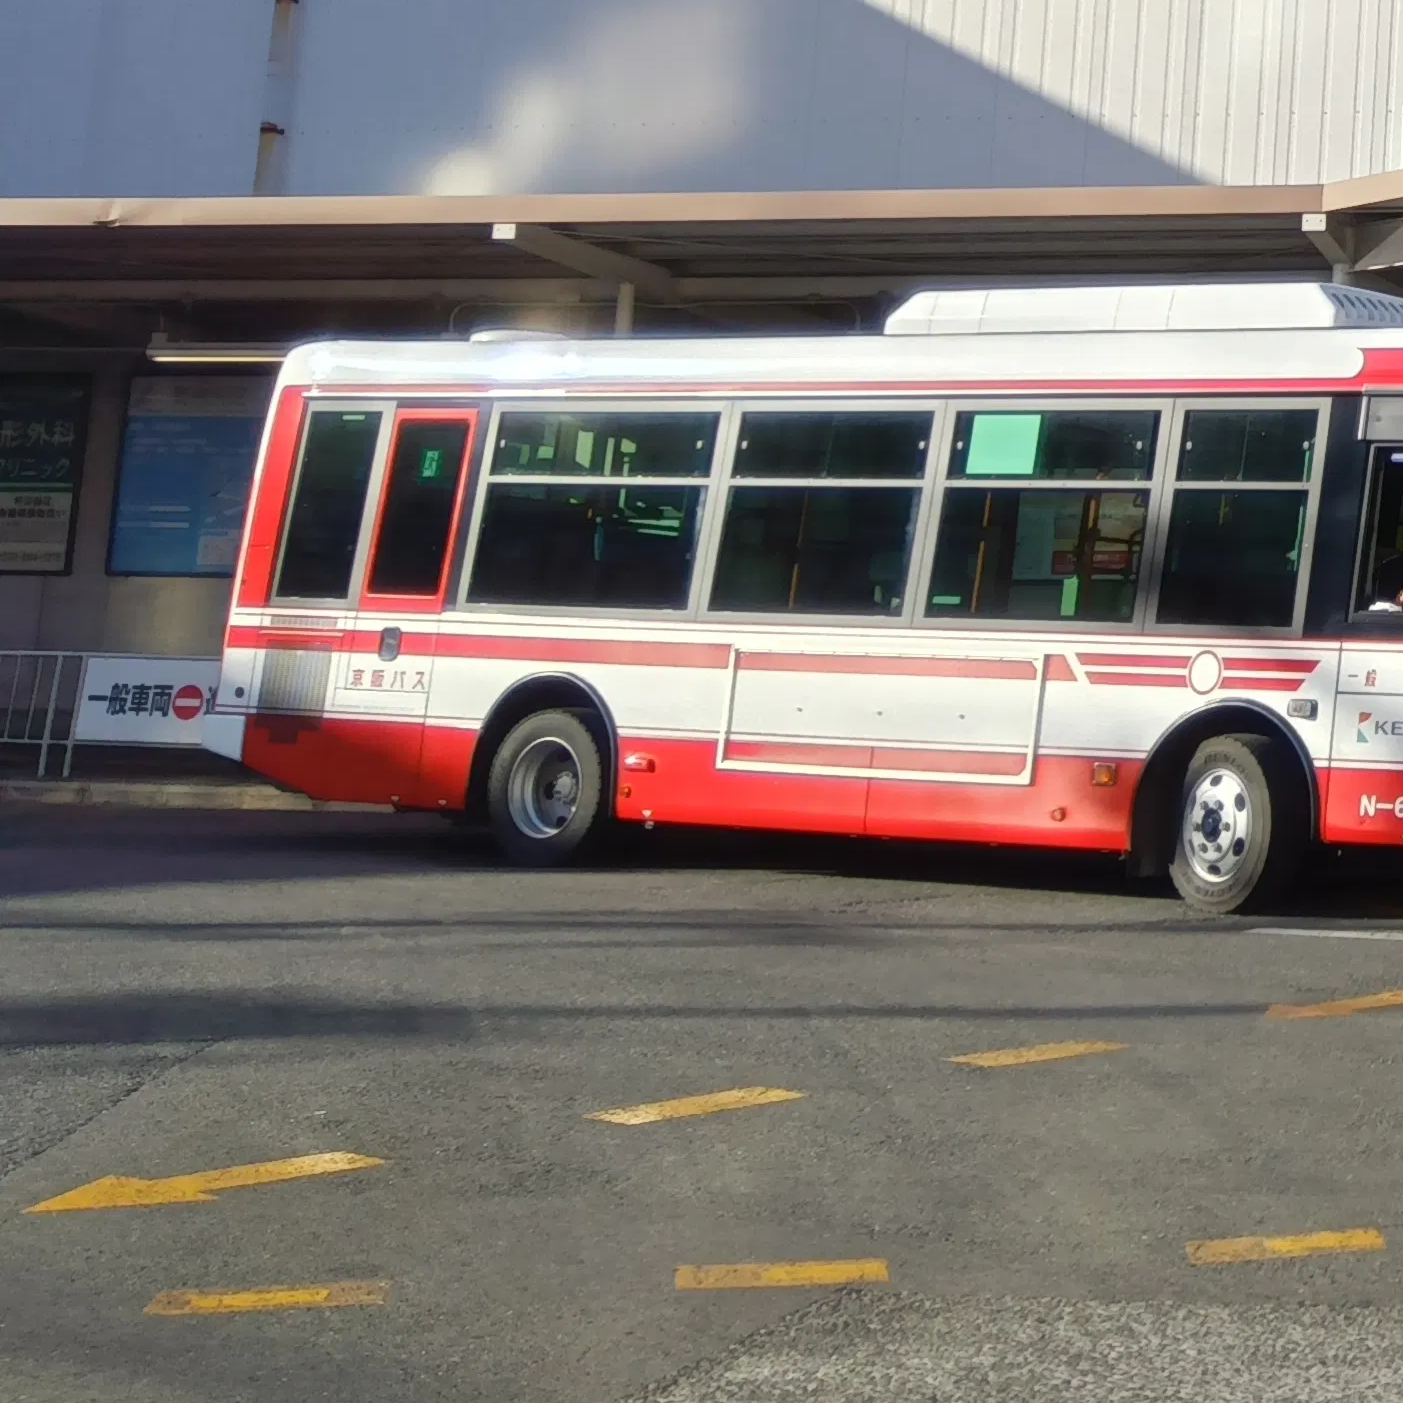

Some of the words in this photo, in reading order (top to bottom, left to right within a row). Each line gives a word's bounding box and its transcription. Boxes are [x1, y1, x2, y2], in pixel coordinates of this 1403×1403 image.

[350, 669, 425, 690] 京阪バス
[88, 682, 174, 717] 一般車両
